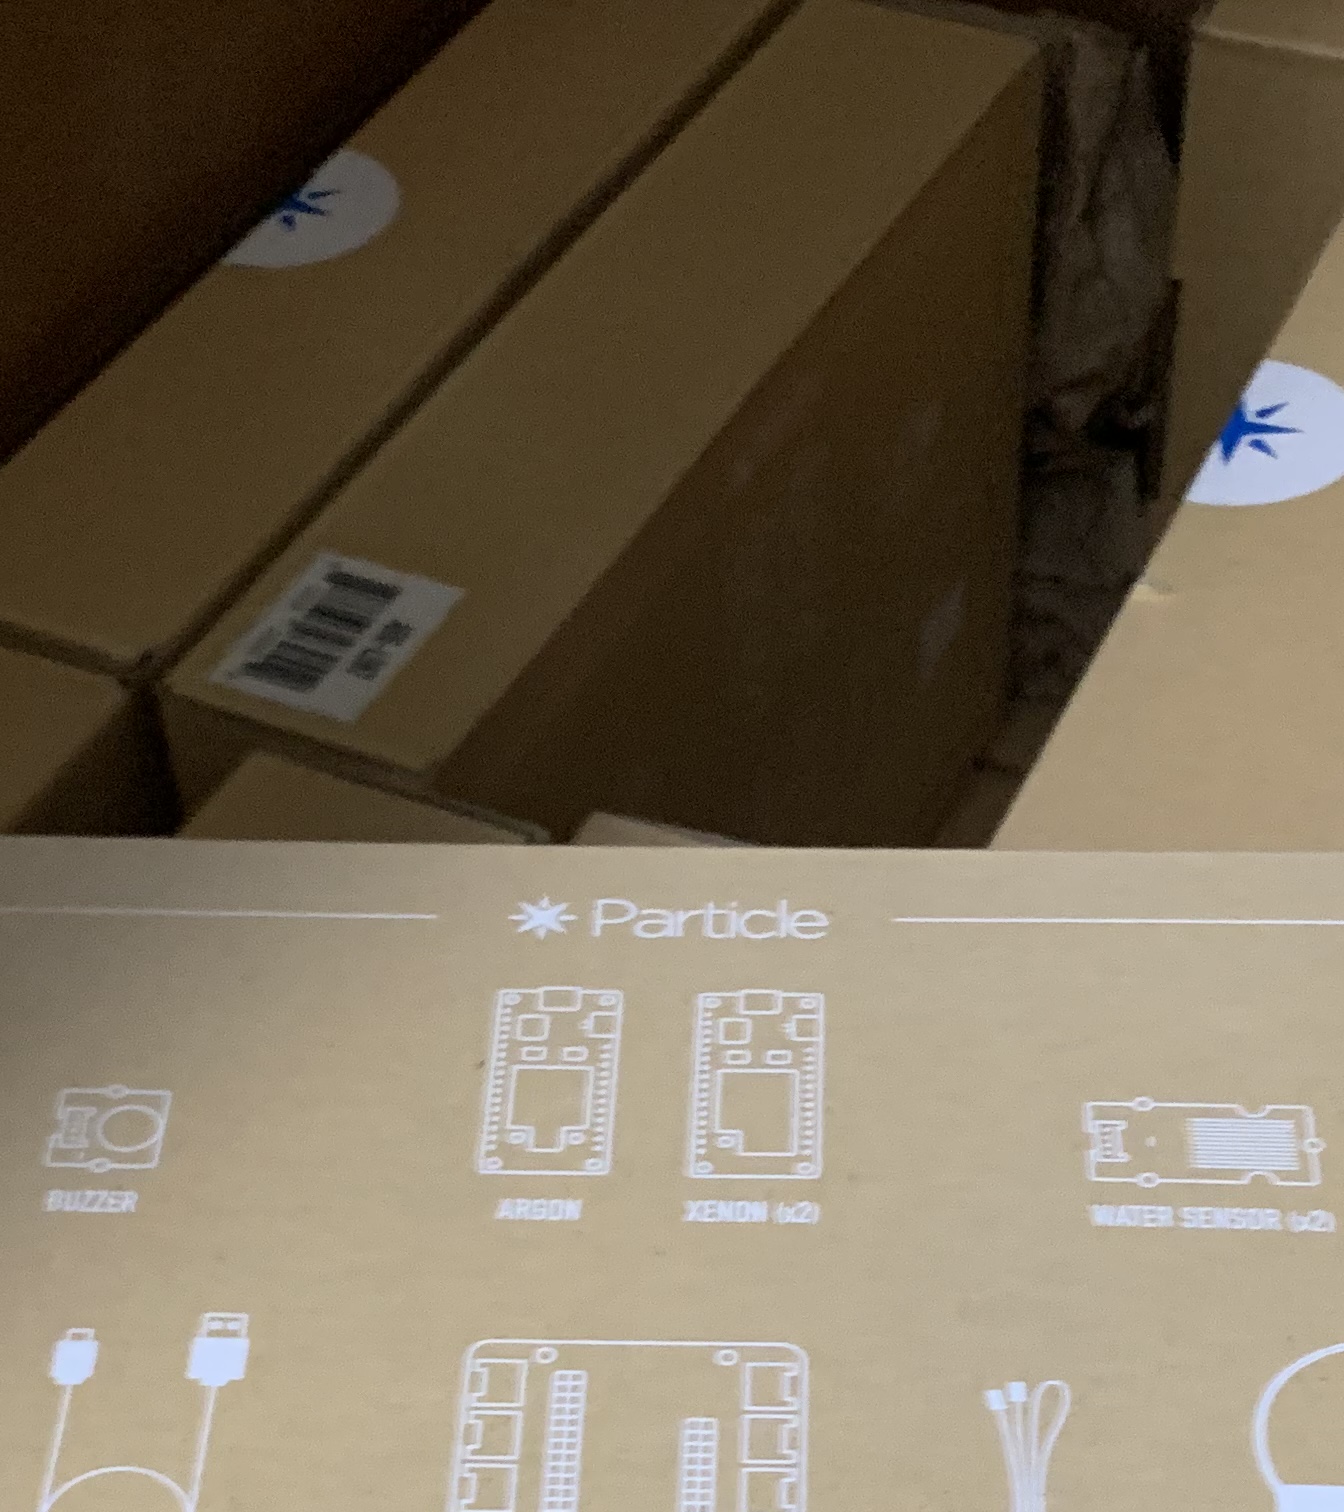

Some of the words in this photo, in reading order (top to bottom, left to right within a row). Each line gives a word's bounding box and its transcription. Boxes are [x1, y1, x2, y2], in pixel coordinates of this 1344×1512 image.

[591, 897, 830, 940] Particle
[494, 1198, 582, 1221] ARGON
[682, 1200, 769, 1223] XENON
